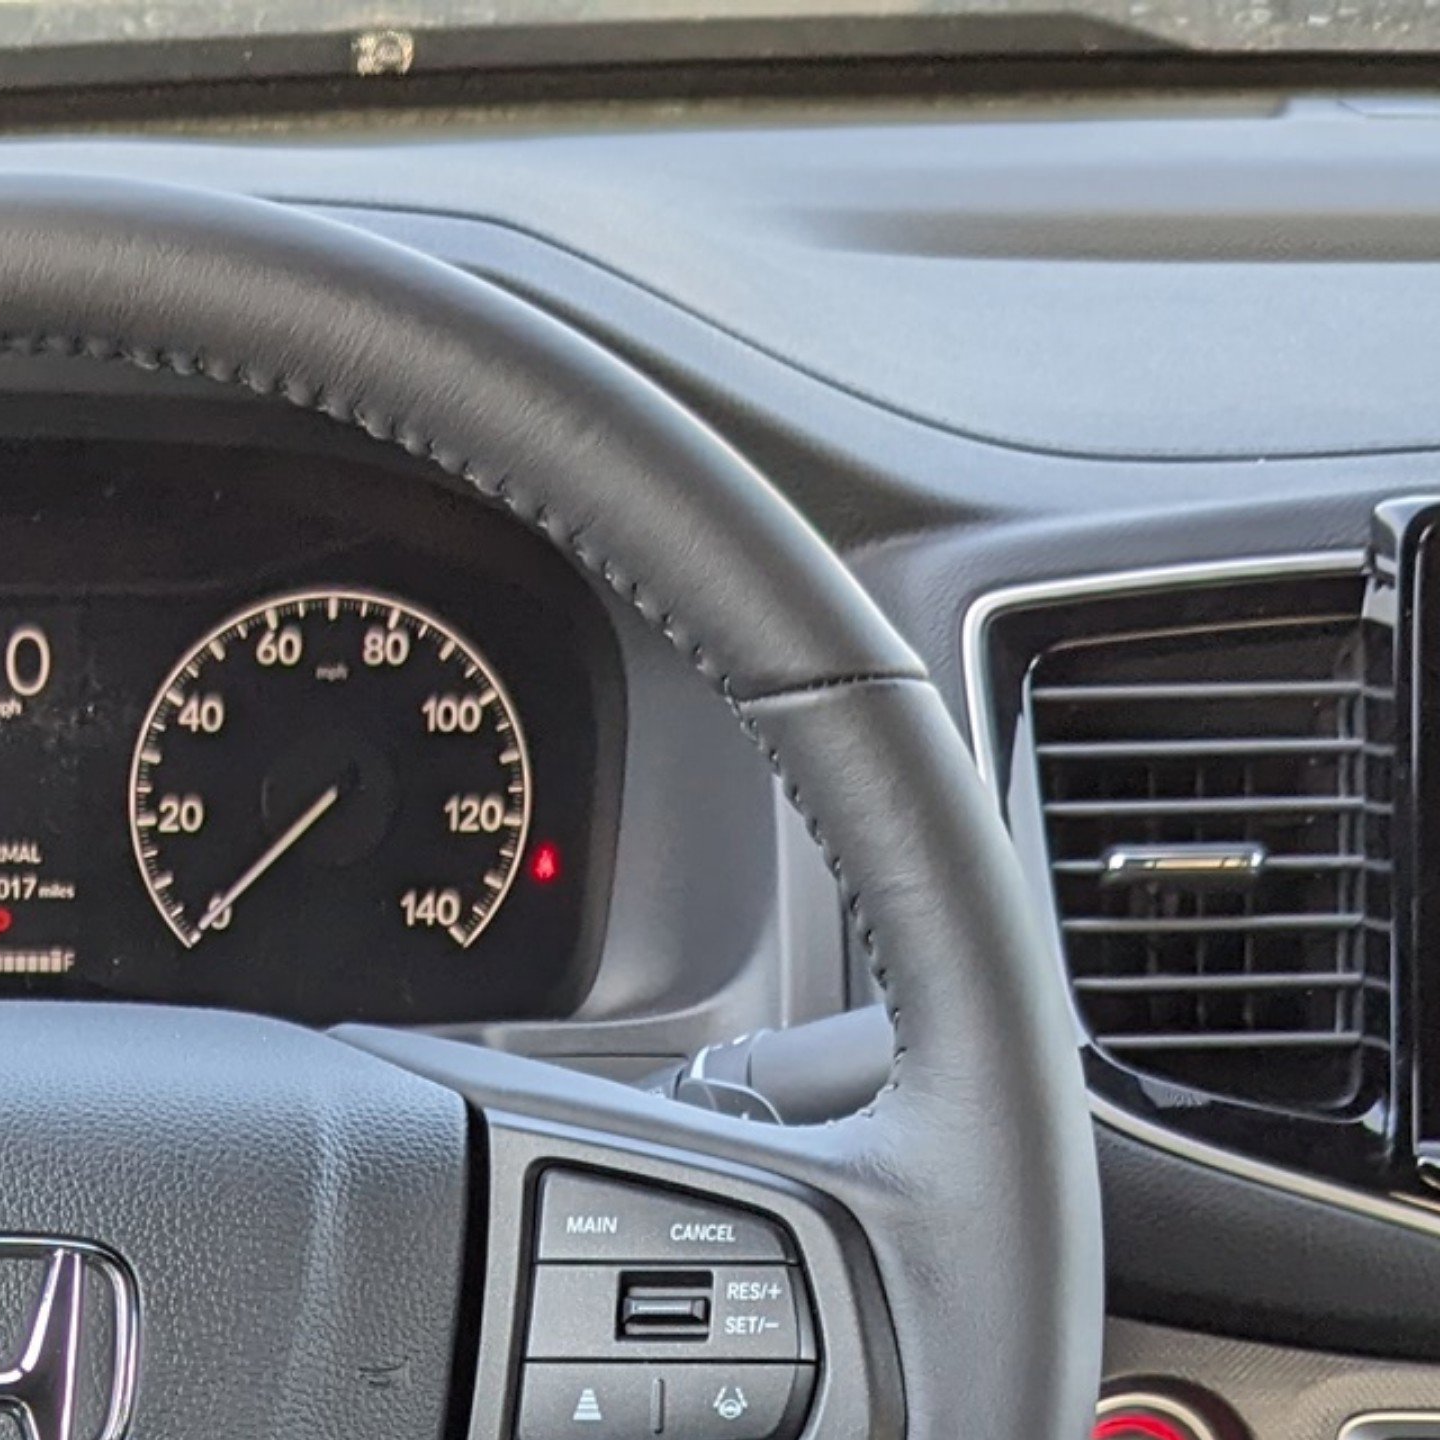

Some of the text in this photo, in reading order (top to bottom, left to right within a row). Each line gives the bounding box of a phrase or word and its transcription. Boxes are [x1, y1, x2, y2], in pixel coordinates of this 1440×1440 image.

[6, 626, 50, 696] 0
[256, 629, 302, 666] 60
[363, 629, 409, 666] 80
[315, 664, 349, 682] mph
[178, 697, 224, 733] 40
[422, 698, 482, 733] 100
[158, 797, 203, 832] 20
[444, 797, 504, 833] 120
[38, 881, 75, 900] miles
[401, 890, 461, 926] 140
[566, 1216, 618, 1235] MAIN
[669, 1223, 737, 1244] CANCEL
[726, 1281, 784, 1301] RES/+
